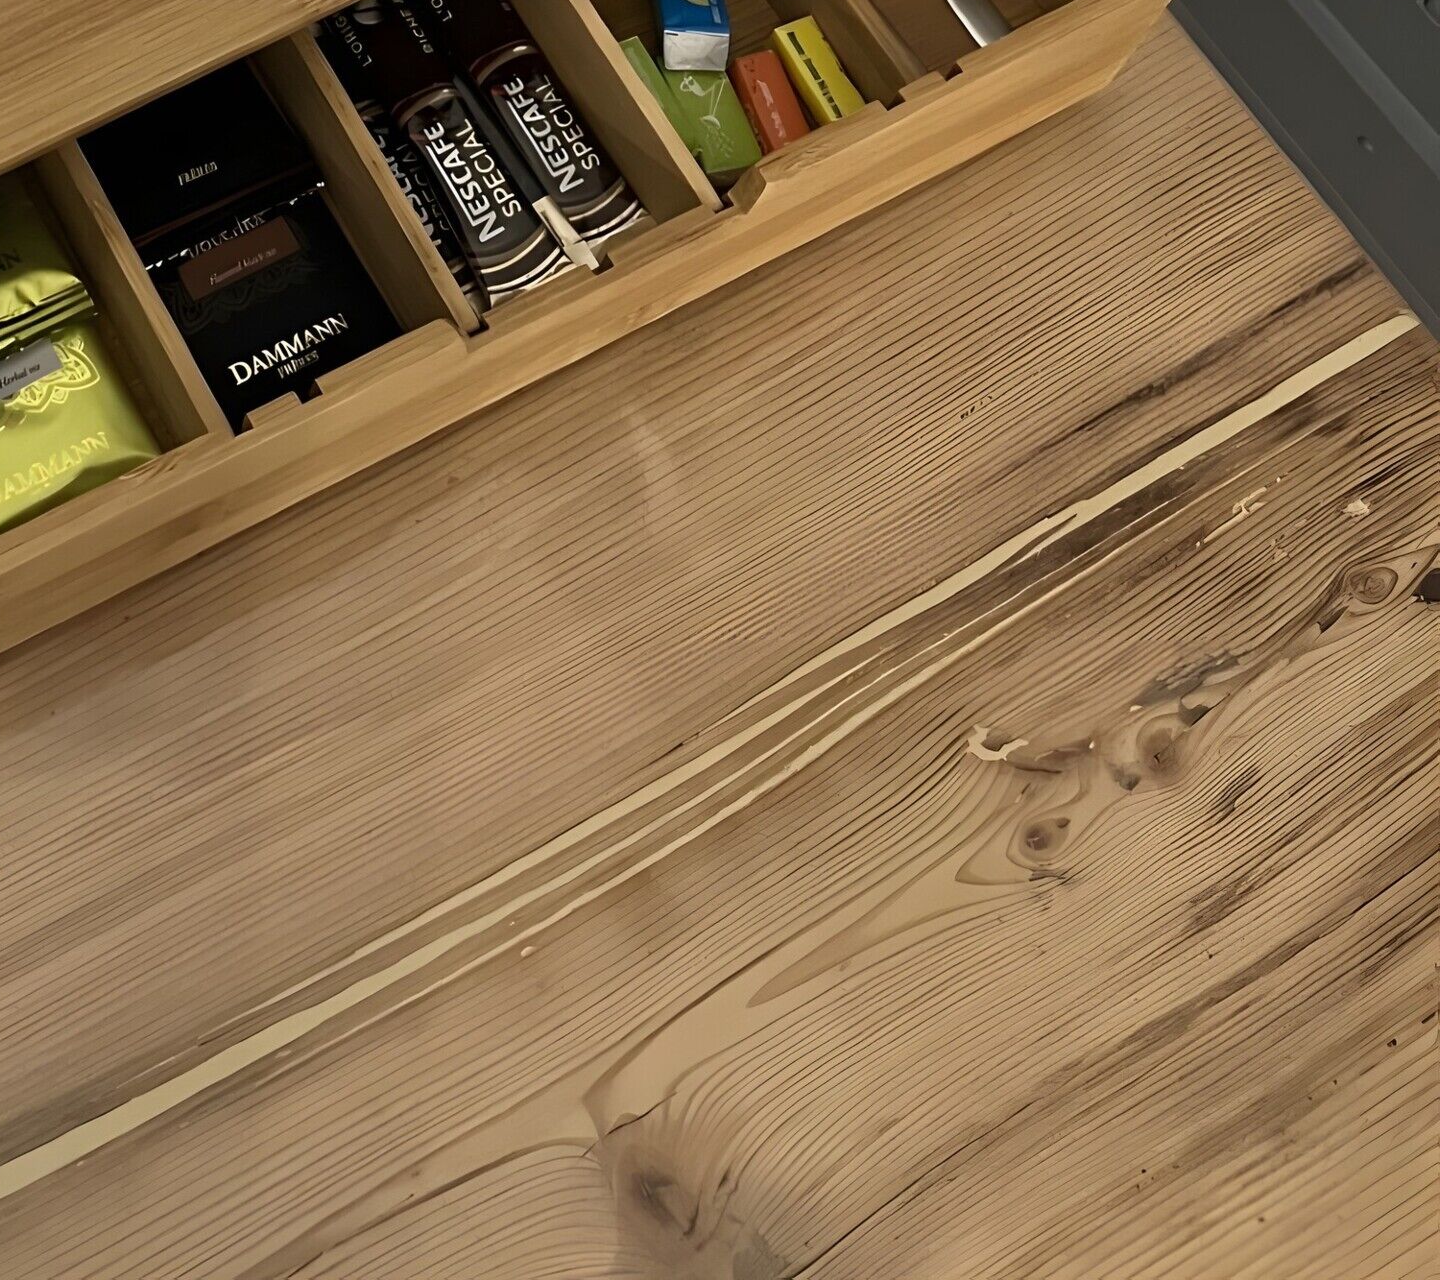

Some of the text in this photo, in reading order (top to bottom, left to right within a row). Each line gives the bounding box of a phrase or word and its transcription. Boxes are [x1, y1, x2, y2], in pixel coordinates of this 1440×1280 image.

[335, 14, 374, 68] L'ORIG
[535, 74, 601, 171] SPECIAL
[455, 118, 523, 218] SPECIAL
[227, 312, 349, 386] DAMMANN
